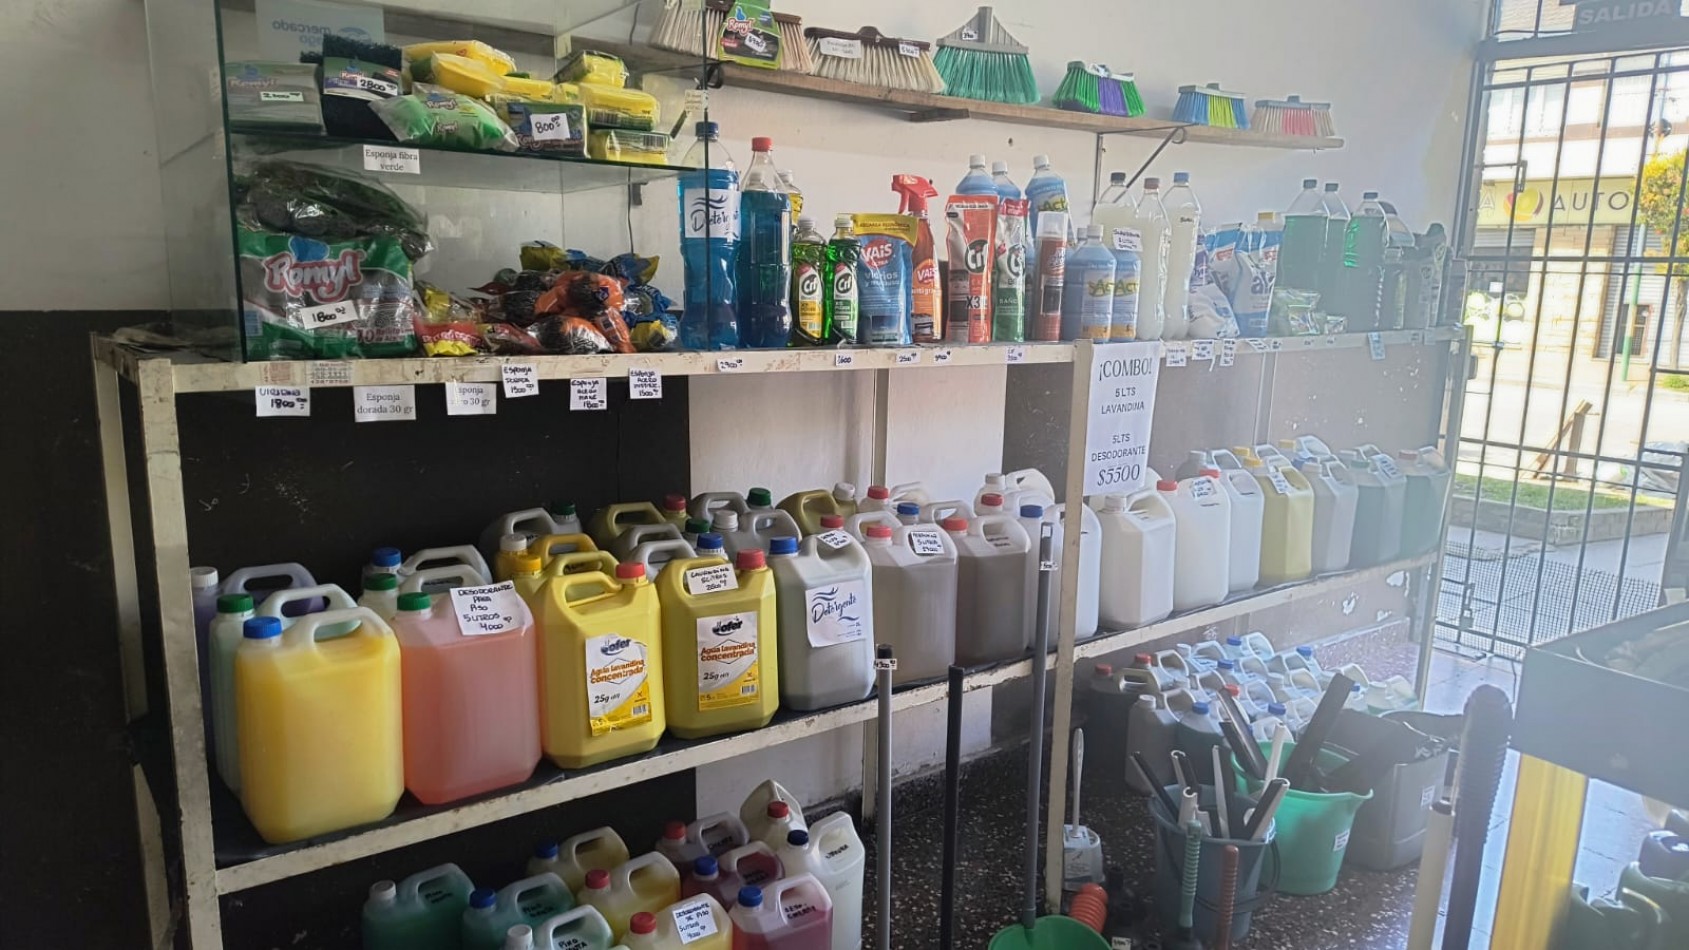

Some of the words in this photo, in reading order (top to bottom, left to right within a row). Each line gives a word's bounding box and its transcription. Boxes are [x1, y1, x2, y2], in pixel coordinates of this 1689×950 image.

[1579, 1, 1673, 25] SALIDA
[727, 17, 754, 37] Romyl
[360, 79, 386, 91] 2800
[534, 120, 555, 134] 800
[365, 149, 397, 160] Esponja
[399, 151, 418, 160] fibra
[380, 162, 404, 171] verde
[264, 250, 362, 303] Romyl
[803, 277, 818, 292] Cif
[838, 276, 852, 292] Cif
[312, 309, 337, 322] 1800
[1099, 357, 1153, 381] ¡COMBO!
[271, 398, 296, 409] 1800
[366, 392, 401, 403] Esponja
[470, 397, 480, 406] 30
[357, 405, 388, 415] dorada
[389, 404, 402, 414] 30
[403, 406, 414, 415] gr
[1101, 400, 1145, 415] LAVANDINA
[1091, 445, 1146, 462] DESODORANTE
[1097, 463, 1141, 487] $5500
[457, 584, 514, 597] DESODORANTE
[479, 622, 504, 632] 4000
[701, 648, 755, 662] concentrada
[703, 672, 719, 681] 25g
[558, 937, 579, 949] PINO
